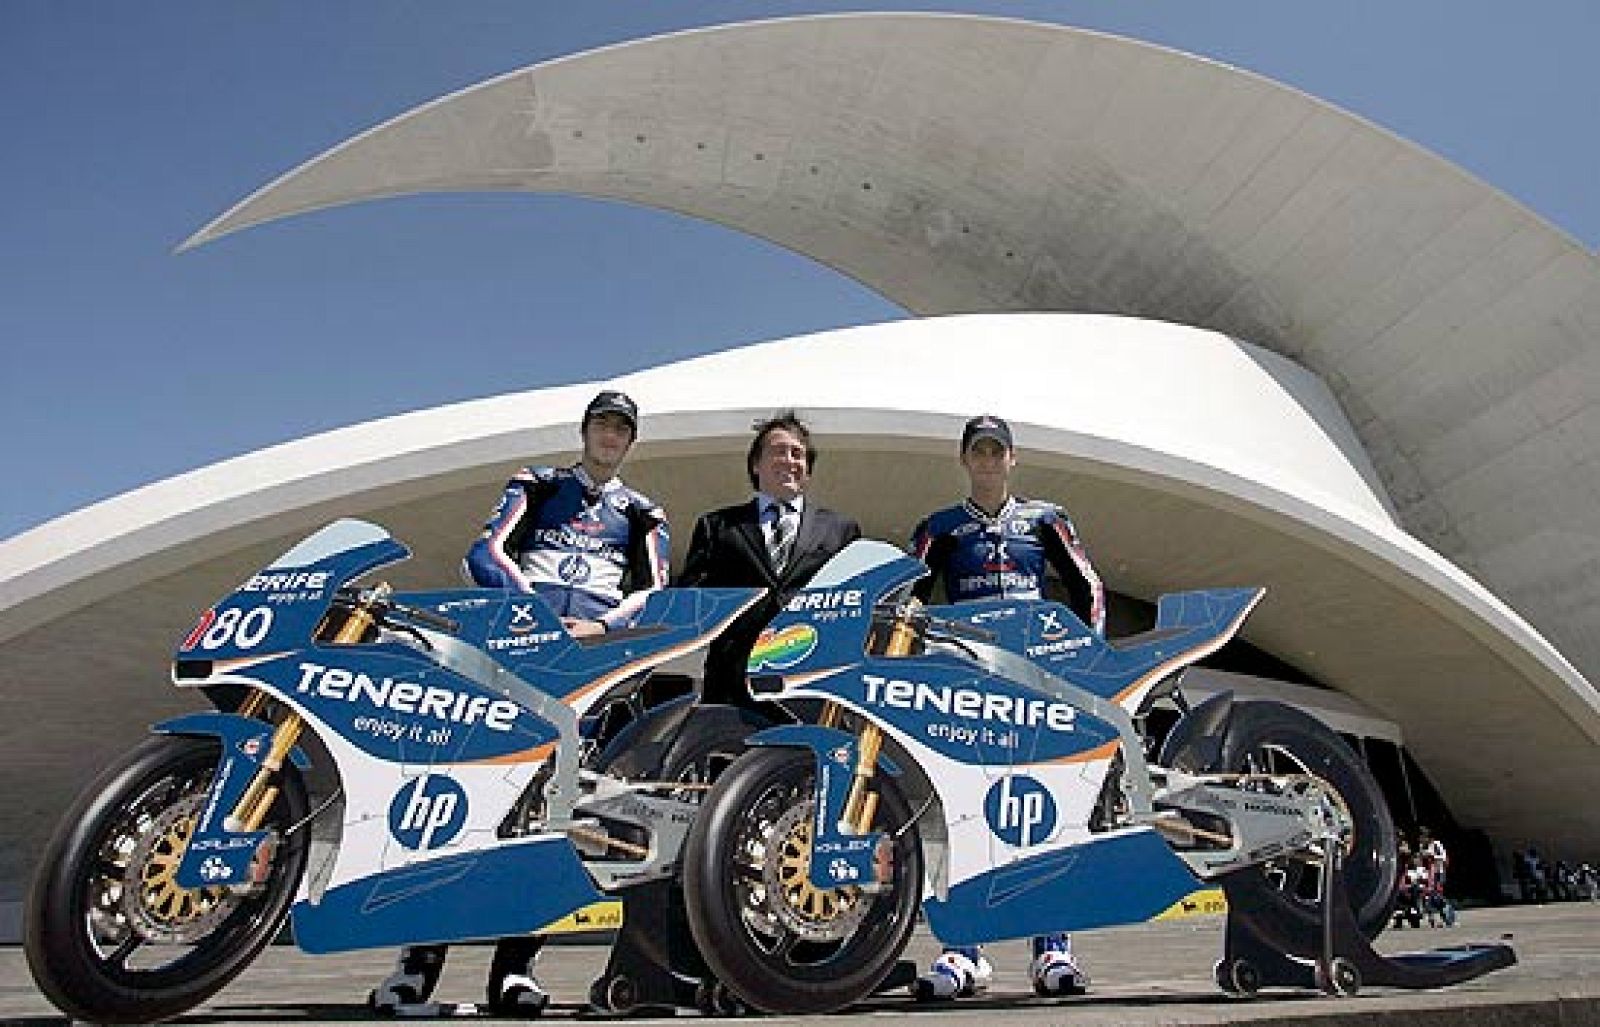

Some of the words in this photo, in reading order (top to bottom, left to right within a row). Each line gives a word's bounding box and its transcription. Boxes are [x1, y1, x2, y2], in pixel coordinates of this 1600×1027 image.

[353, 715, 405, 742] enjoy
[409, 722, 423, 742] it
[427, 727, 452, 747] all
[927, 723, 979, 746] enjoy
[981, 726, 996, 746] it
[997, 729, 1020, 749] all
[398, 774, 459, 850] hp
[1000, 774, 1043, 848] hp
